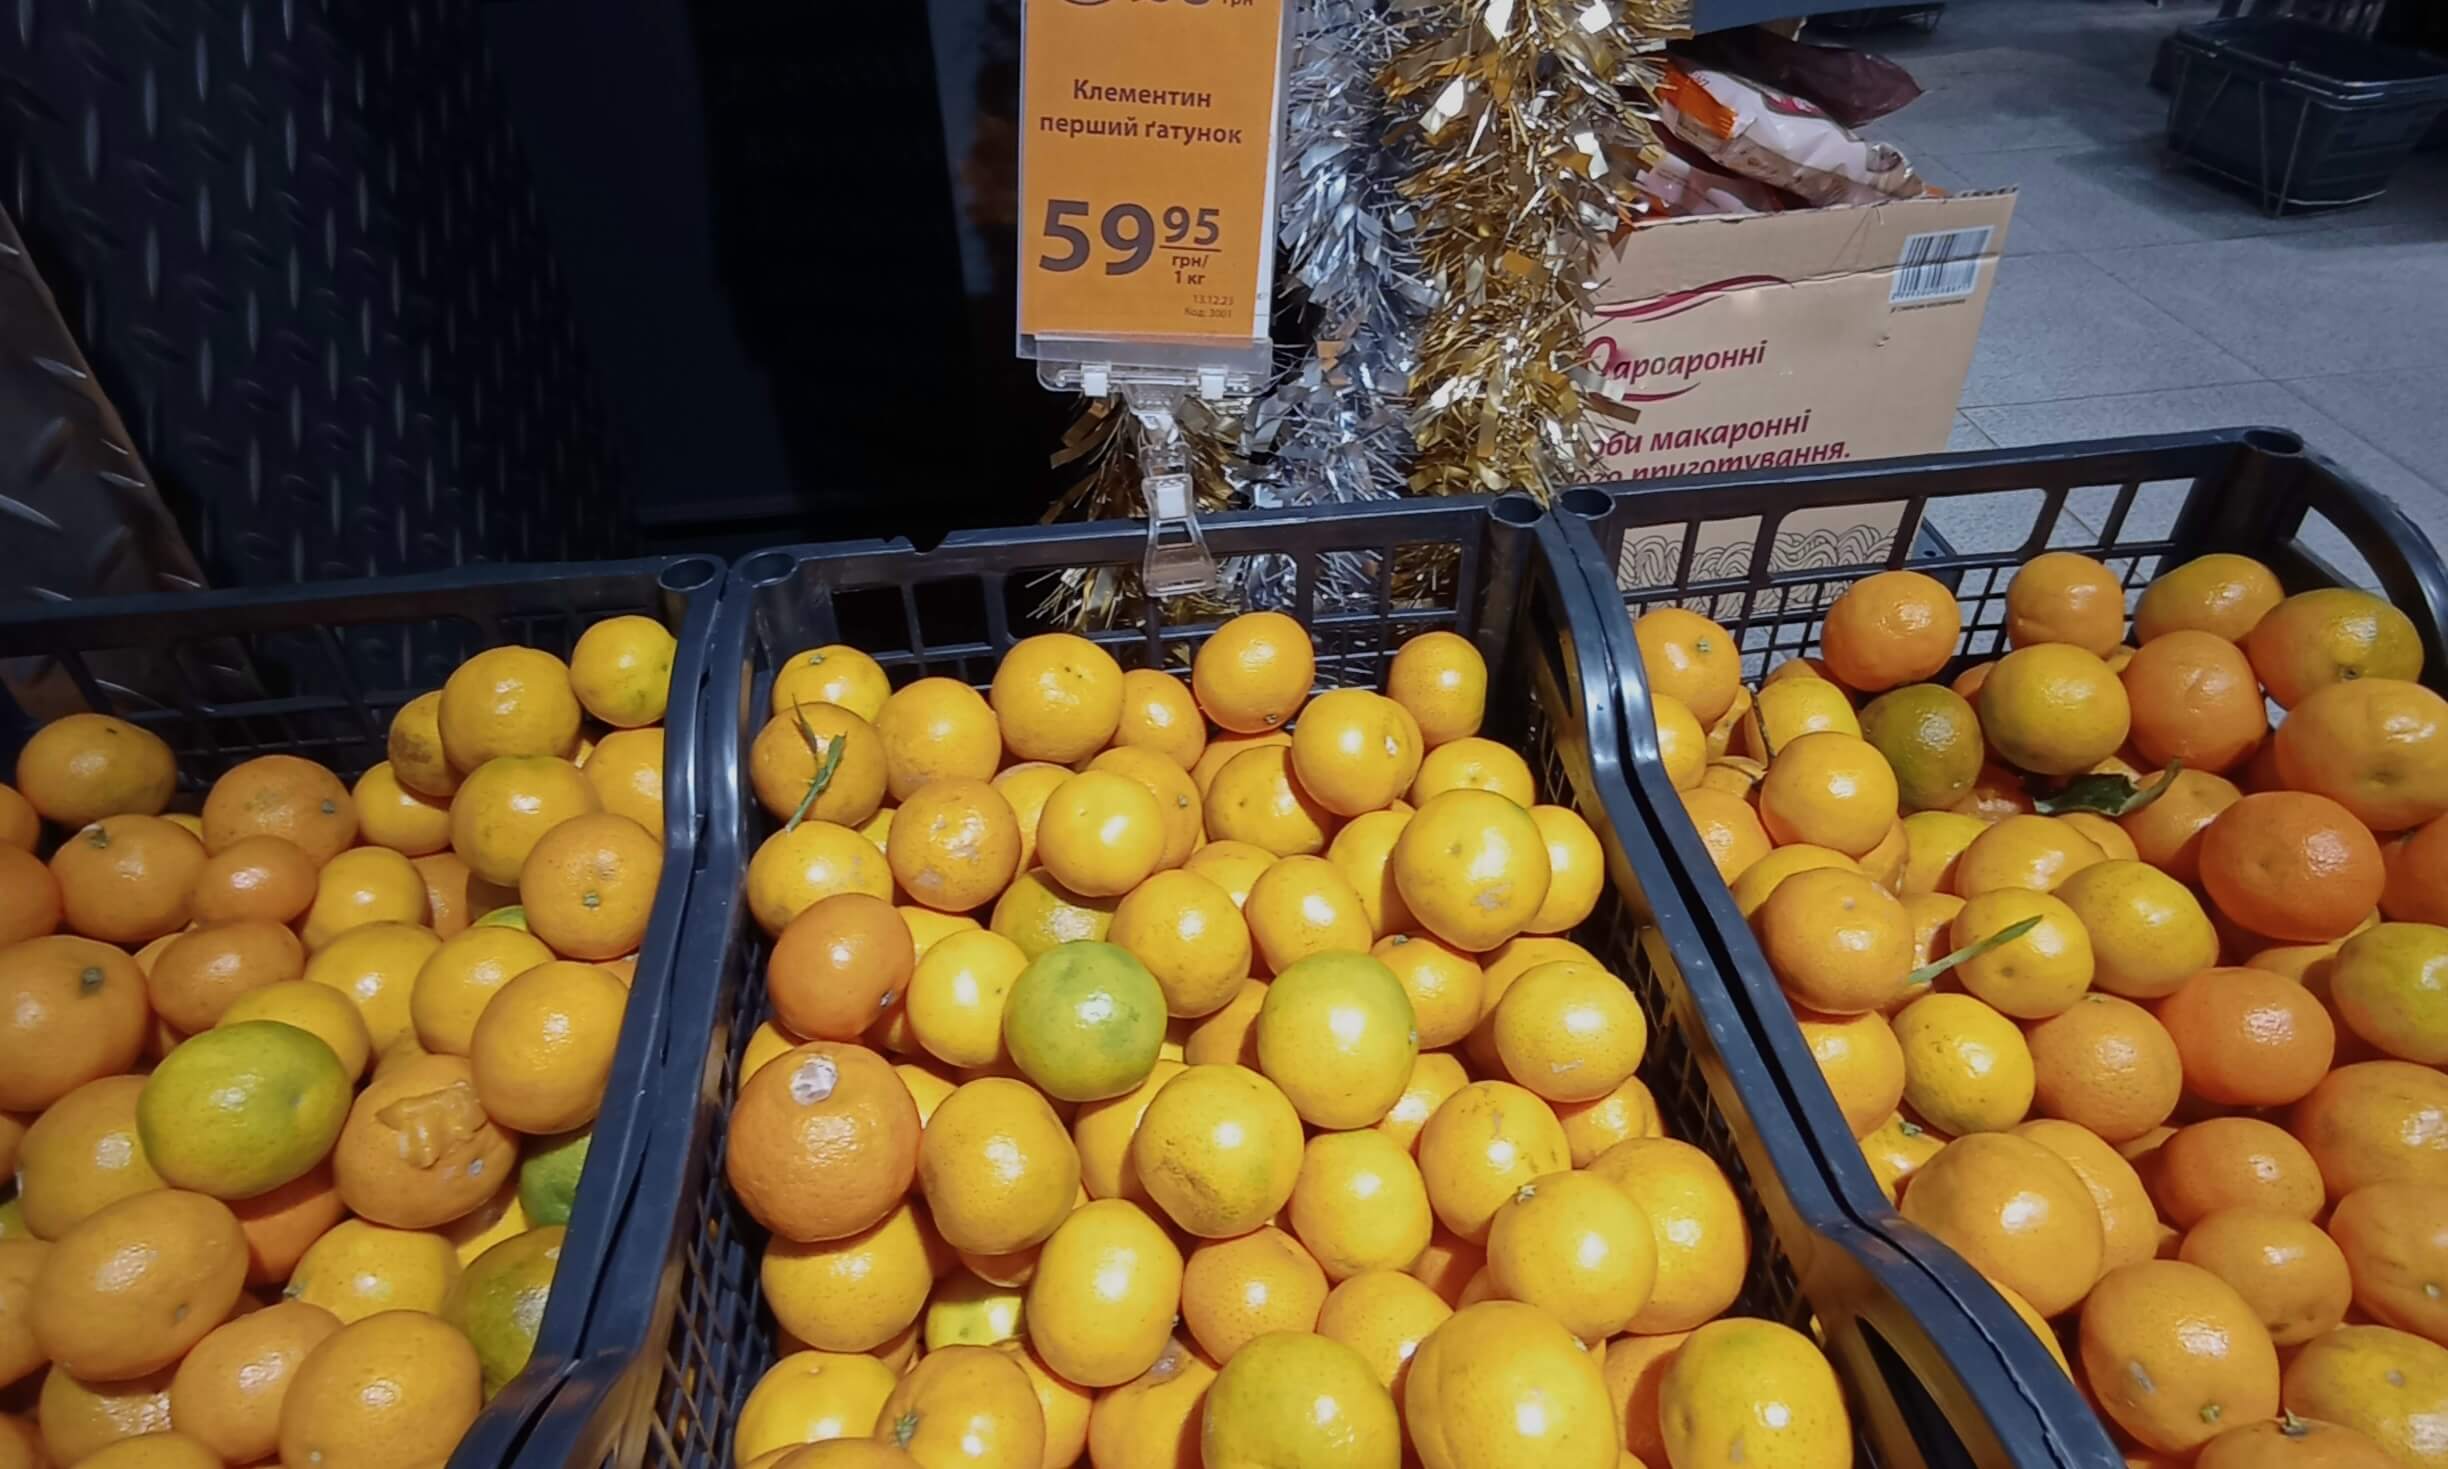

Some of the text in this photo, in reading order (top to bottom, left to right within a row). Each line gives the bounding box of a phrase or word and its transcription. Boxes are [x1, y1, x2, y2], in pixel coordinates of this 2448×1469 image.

[1073, 79, 1212, 108] Клементин
[1039, 115, 1242, 145] перший ґатунок
[1039, 199, 1220, 276] 59 95
[1172, 254, 1209, 269] грн/
[1174, 270, 1206, 285] 1 кг
[1649, 409, 1811, 449] макаронні
